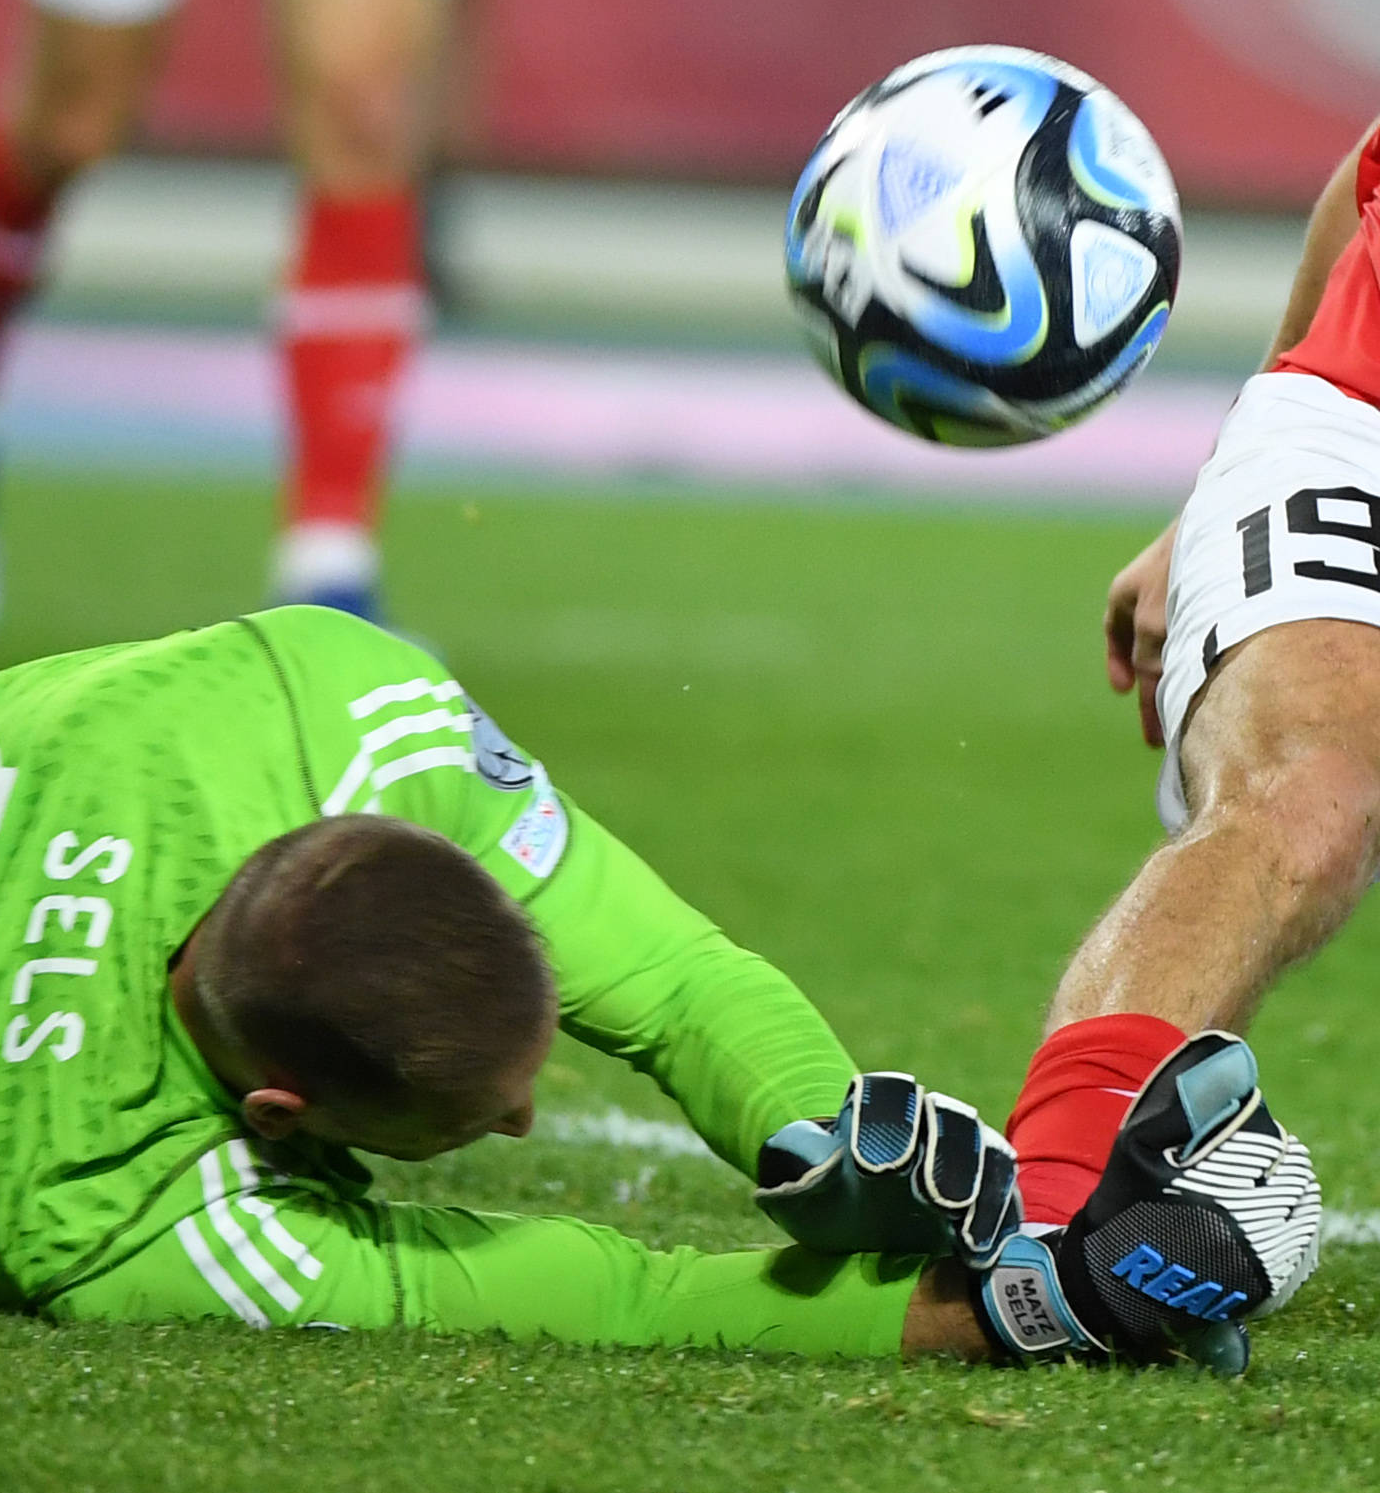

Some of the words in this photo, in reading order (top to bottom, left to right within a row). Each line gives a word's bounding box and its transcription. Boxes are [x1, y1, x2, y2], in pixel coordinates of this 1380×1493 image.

[4, 829, 133, 1063] SELS
[1004, 1283, 1038, 1336] SELS
[1021, 1277, 1056, 1334] MATZ
[1110, 1243, 1248, 1322] REAL
